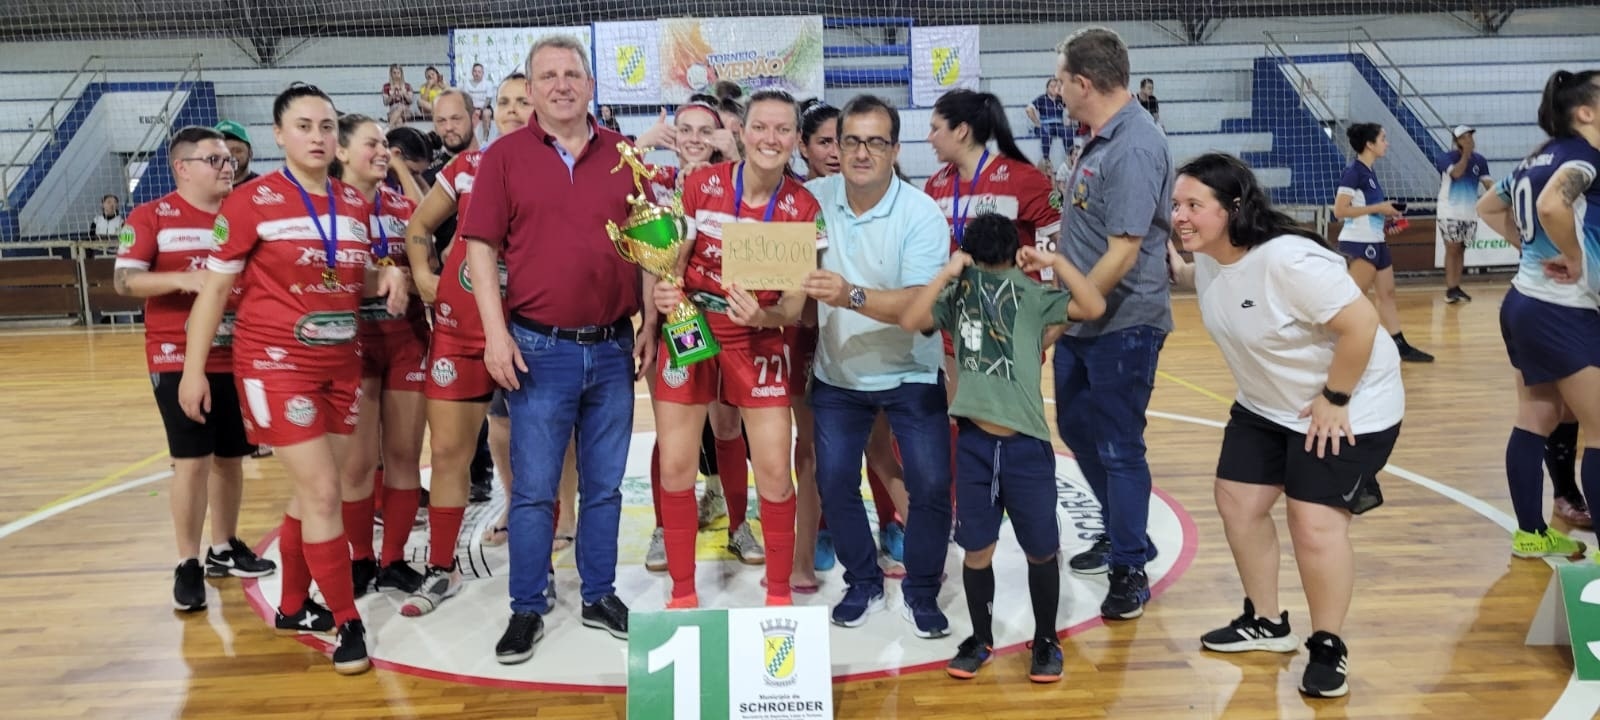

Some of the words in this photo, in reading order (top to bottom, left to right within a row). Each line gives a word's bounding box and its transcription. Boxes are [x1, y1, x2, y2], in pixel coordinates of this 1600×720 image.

[707, 50, 757, 64] TORNEIO
[714, 56, 785, 80] VERÃO
[753, 354, 783, 385] 77
[648, 625, 701, 720] 1
[739, 701, 824, 713] SCHROEDER
